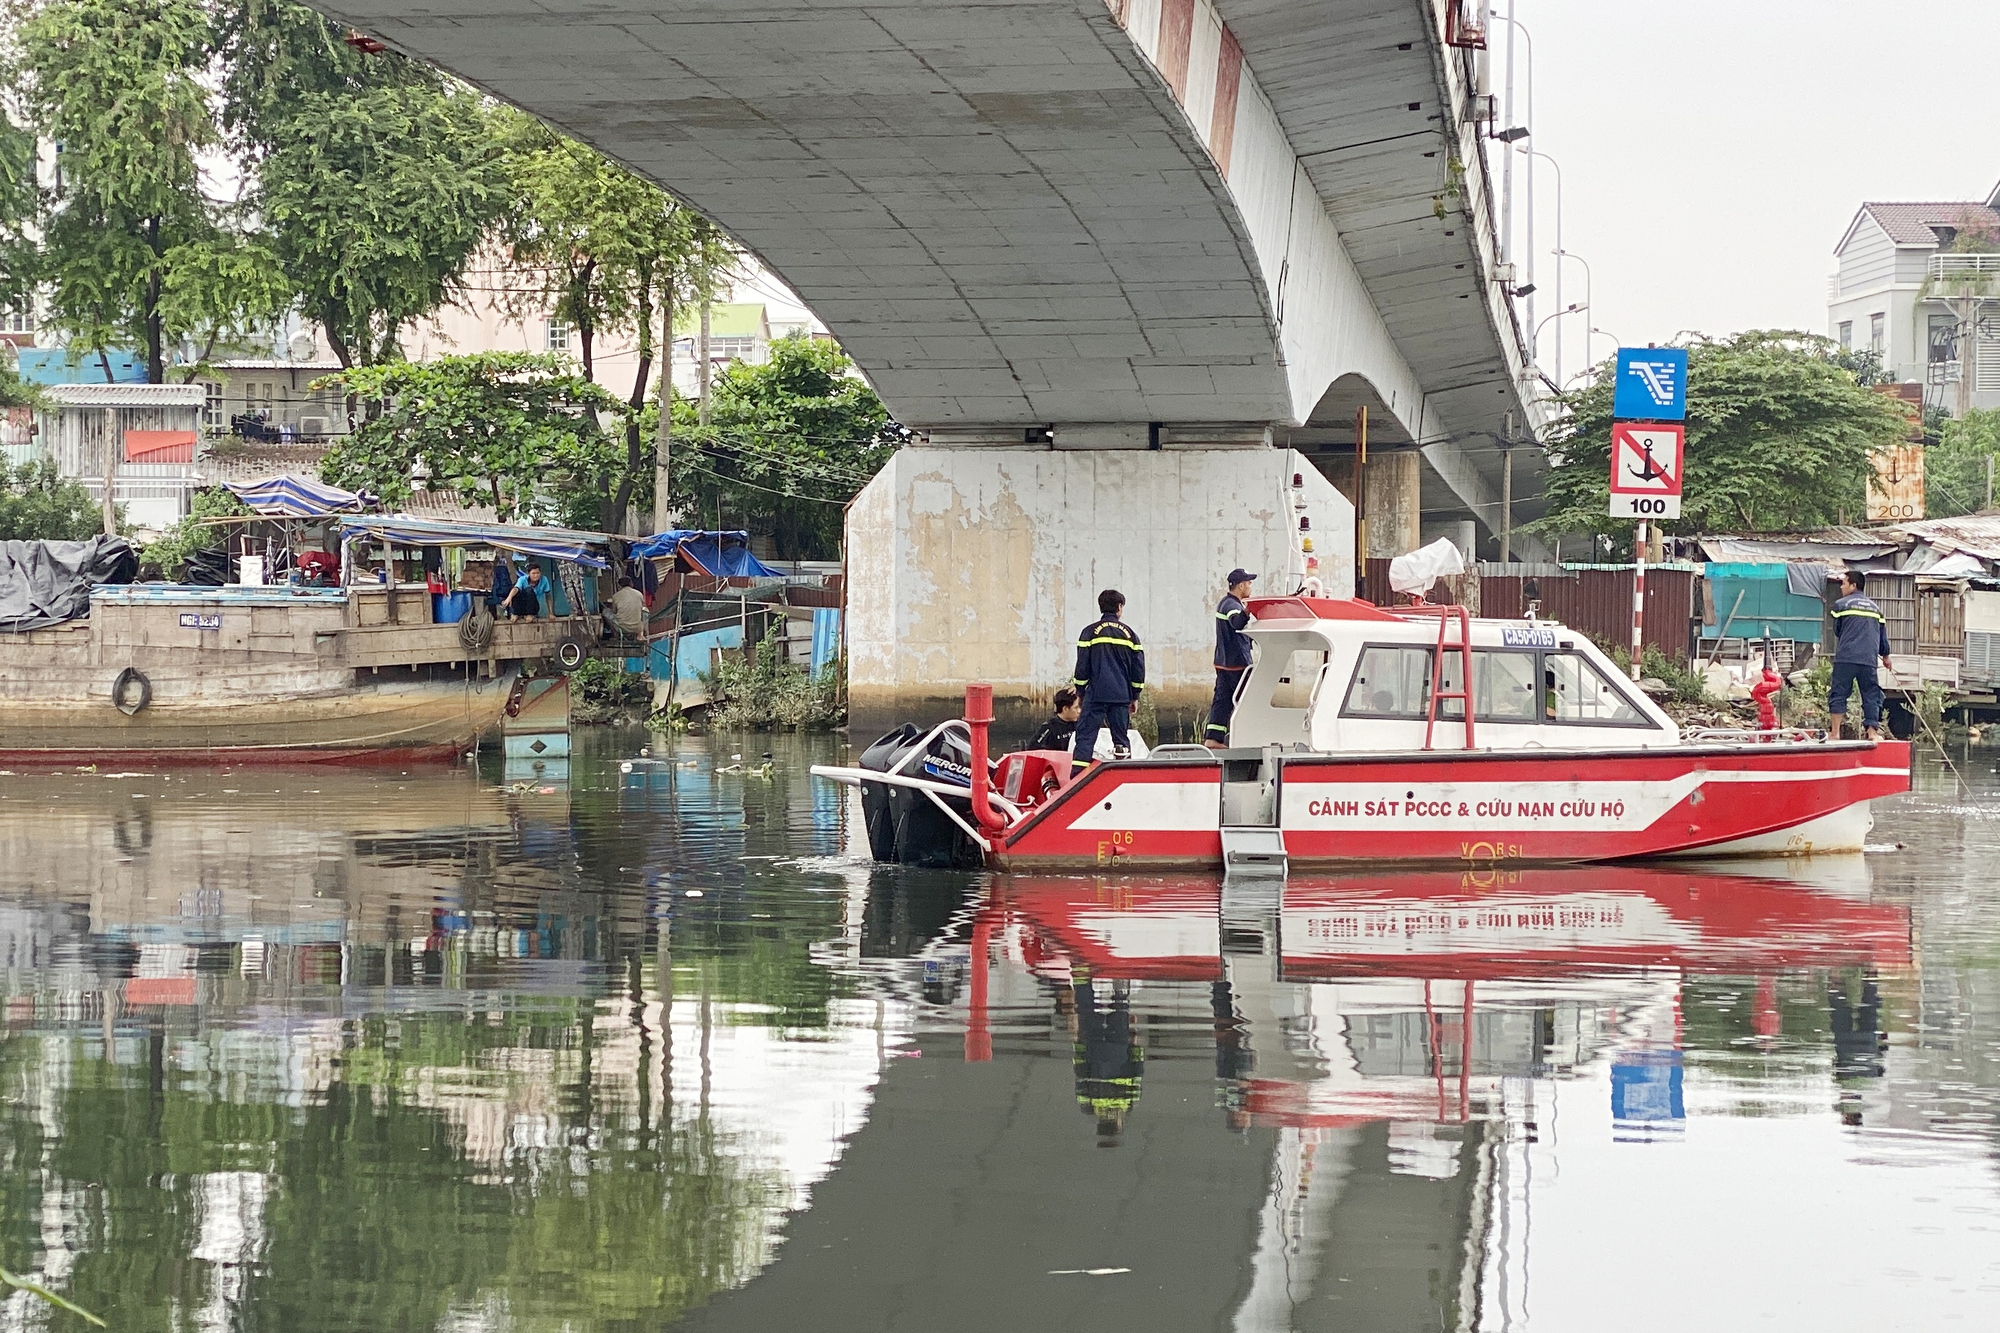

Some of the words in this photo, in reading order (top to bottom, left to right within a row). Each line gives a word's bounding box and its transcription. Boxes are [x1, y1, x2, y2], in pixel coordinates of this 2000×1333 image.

[1630, 498, 1666, 514] 100
[1878, 504, 1913, 518] 200
[1504, 629, 1554, 646] CA50-0165
[923, 753, 972, 777] MERCUR
[1308, 797, 1359, 816] CẢNH
[1364, 797, 1400, 817] SÁT
[1405, 801, 1452, 817] PCCC
[1457, 802, 1470, 817] &
[1476, 798, 1512, 817] CỨU
[1518, 802, 1555, 820] NẠN
[1560, 798, 1596, 817] CỨU
[1601, 799, 1625, 820] HỘ
[1112, 831, 1134, 845] 06
